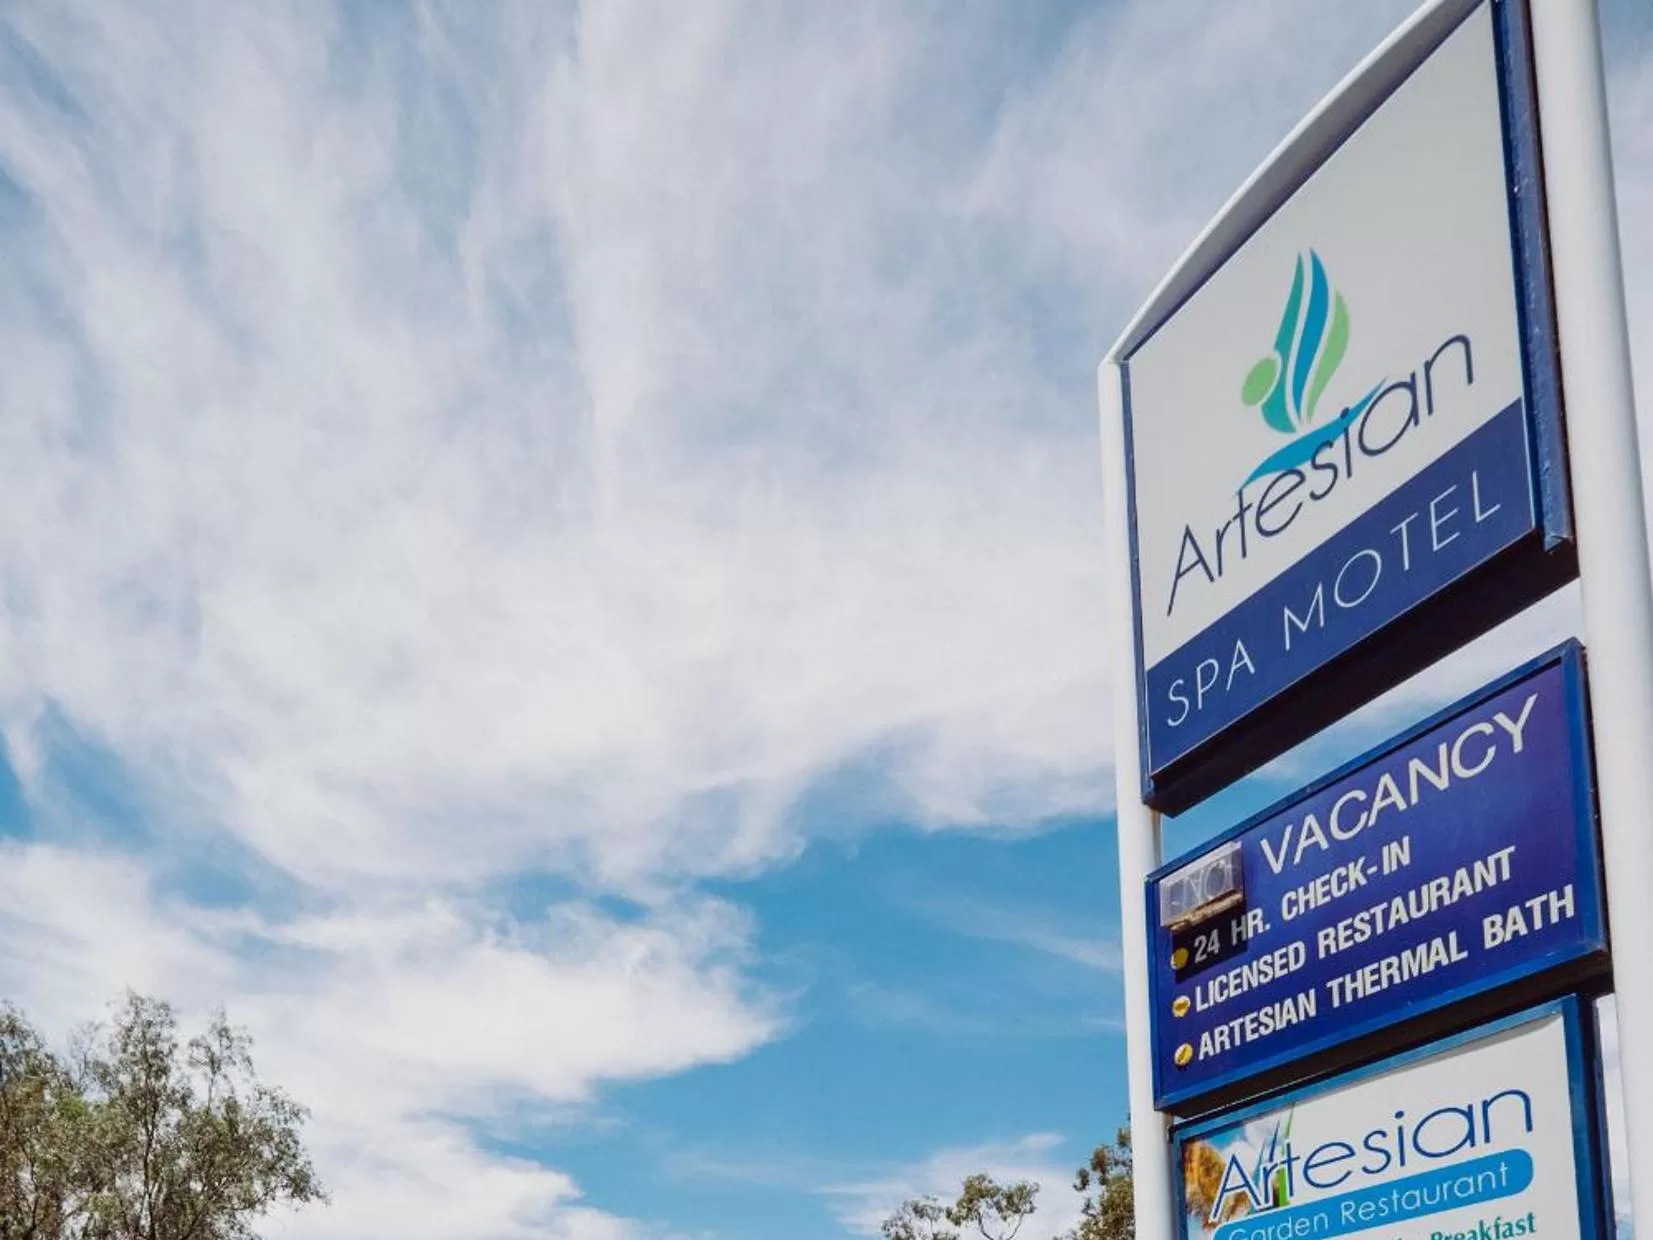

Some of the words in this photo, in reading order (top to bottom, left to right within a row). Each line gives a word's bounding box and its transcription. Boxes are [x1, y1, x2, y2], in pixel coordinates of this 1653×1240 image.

[1166, 334, 1475, 617] Artesian
[1166, 639, 1256, 727] SPA
[1282, 470, 1502, 650] MOTEL
[1259, 693, 1538, 876] VACANCY
[1194, 928, 1221, 964] 24
[1231, 907, 1271, 946] HR.
[1280, 836, 1412, 922] CHECK-IN
[1195, 944, 1307, 1013] LICENSED
[1317, 846, 1516, 960] RESTAURANT
[1197, 990, 1318, 1062] ARTESIAN
[1326, 930, 1469, 1008] THERMAL
[1483, 884, 1575, 950] BATH
[1210, 1088, 1534, 1221] Artesian
[1340, 1162, 1510, 1225] Restaurant
